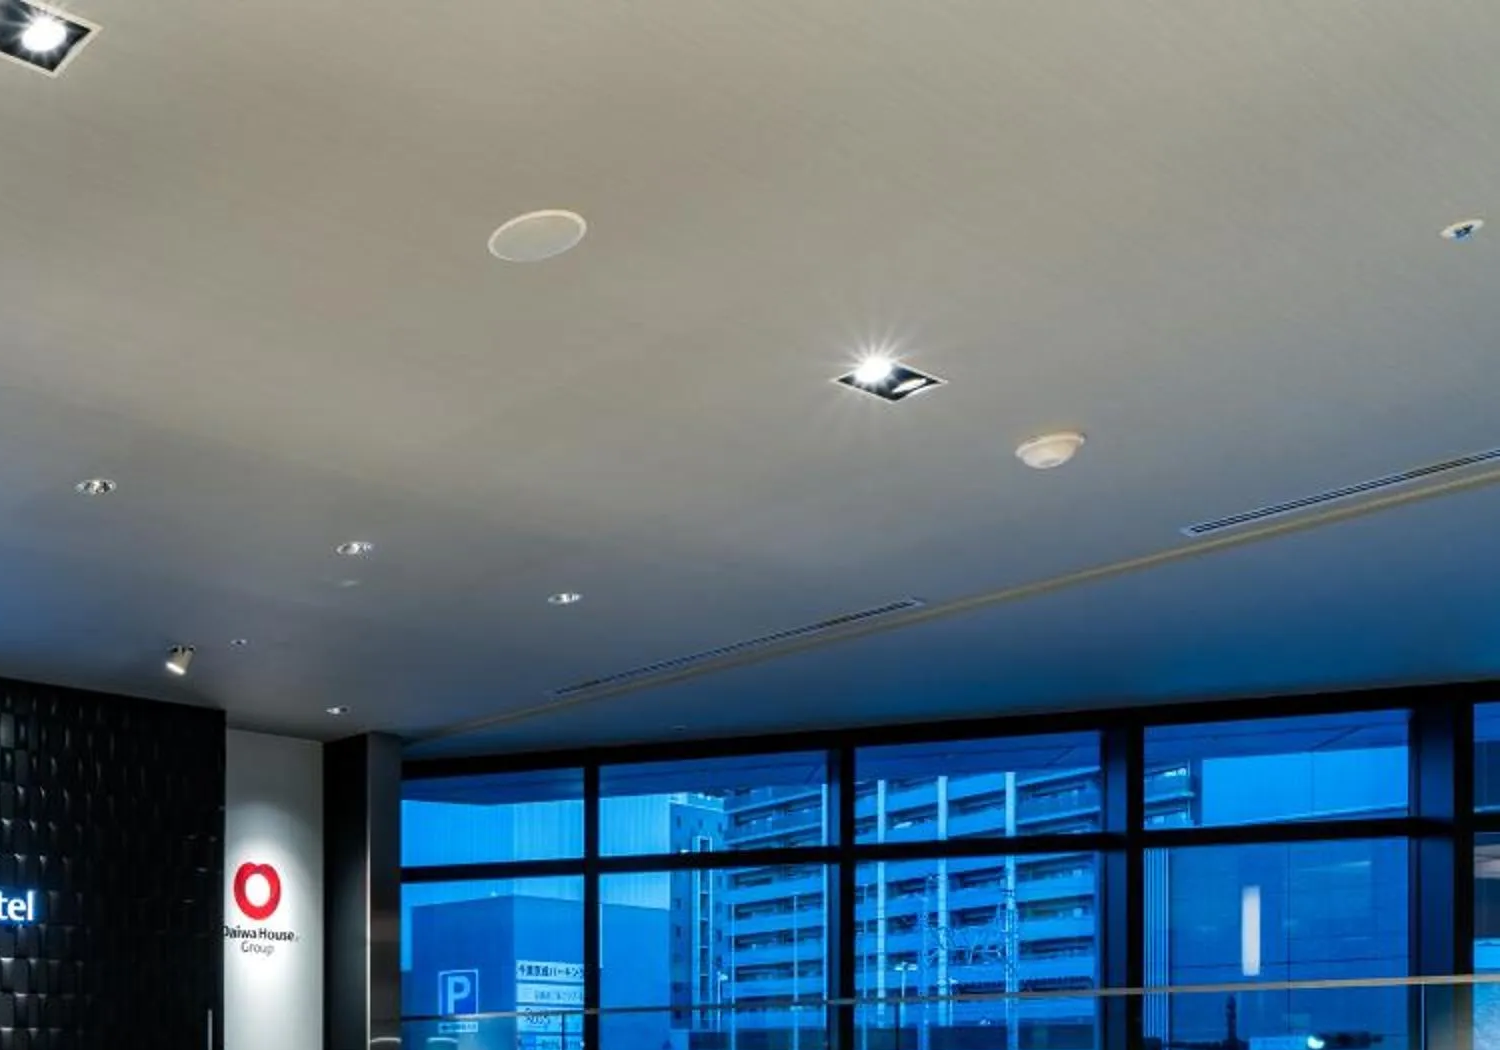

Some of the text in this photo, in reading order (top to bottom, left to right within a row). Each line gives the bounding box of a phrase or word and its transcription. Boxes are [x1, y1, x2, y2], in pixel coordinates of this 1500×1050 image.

[222, 925, 295, 941] Daiwa House
[241, 940, 275, 957] Group
[447, 975, 471, 1015] P
